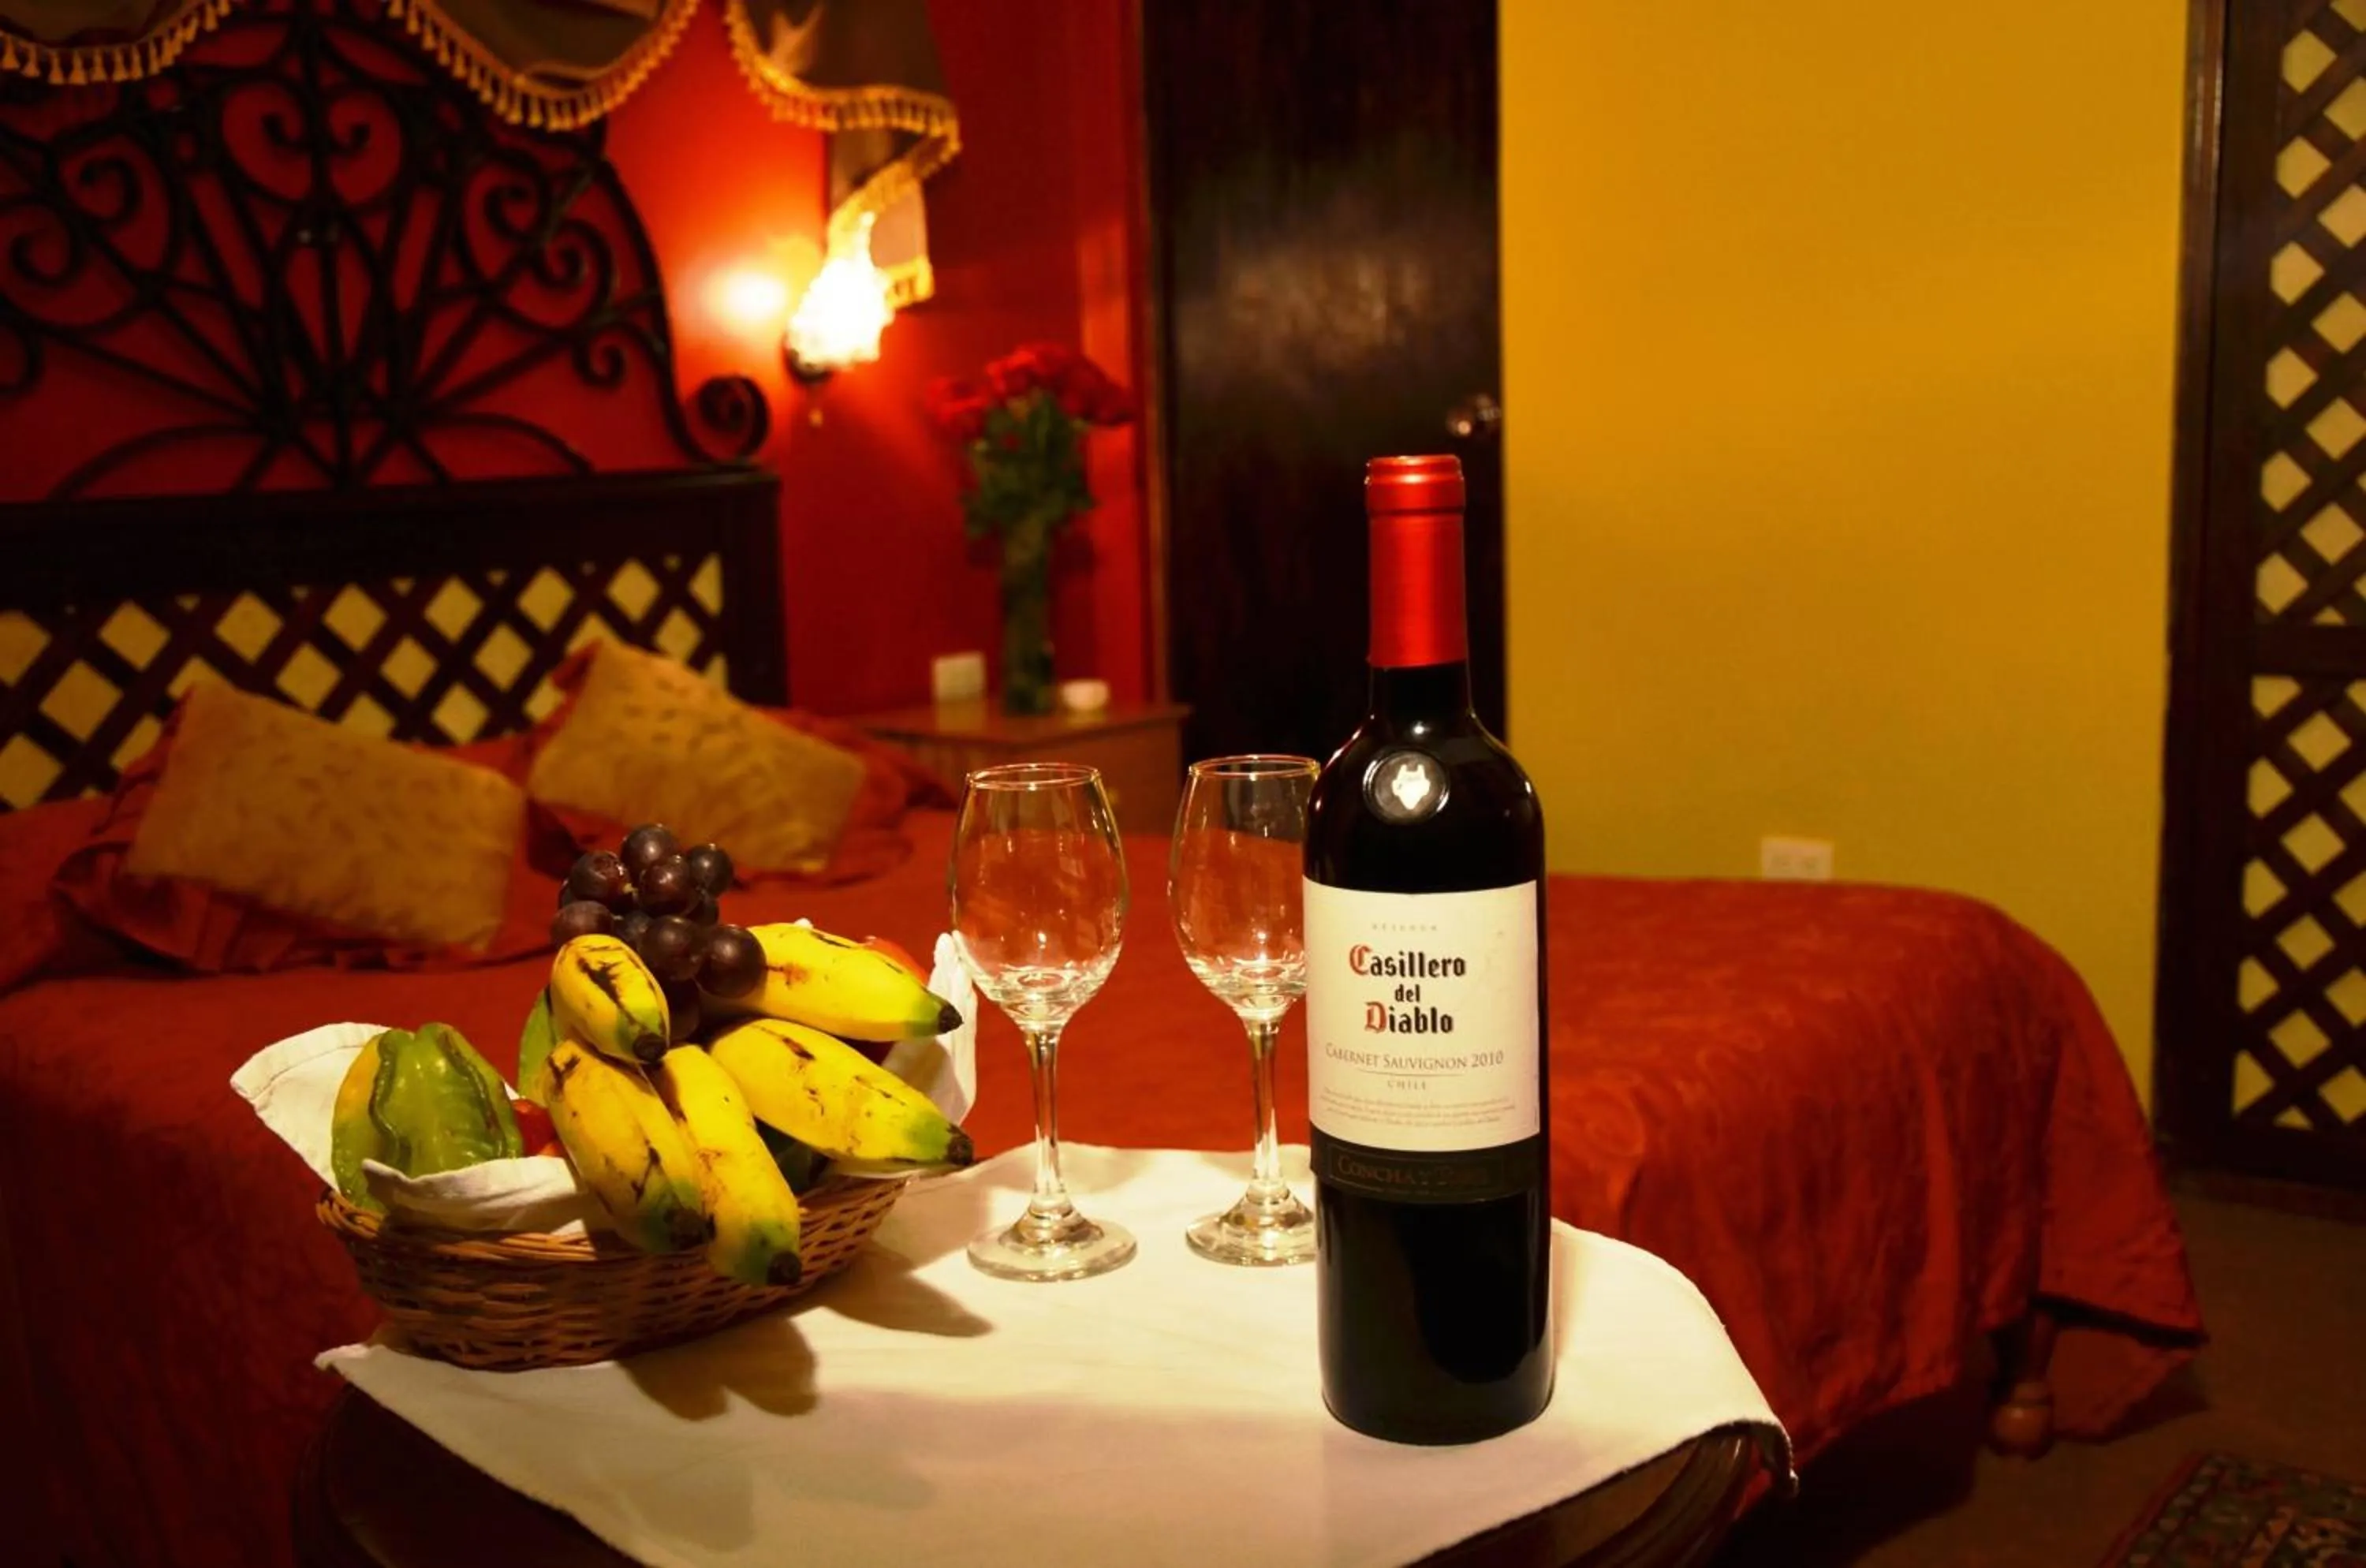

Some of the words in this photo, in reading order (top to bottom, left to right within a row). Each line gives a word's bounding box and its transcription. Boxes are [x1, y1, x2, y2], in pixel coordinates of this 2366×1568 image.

[1349, 943, 1466, 978] Casillero
[1394, 984, 1421, 1002] del
[1364, 1001, 1454, 1034] Diablo
[1325, 1043, 1380, 1068] CABERNET
[1383, 1054, 1468, 1070] SAUVIGNON
[1472, 1050, 1504, 1067] 2010
